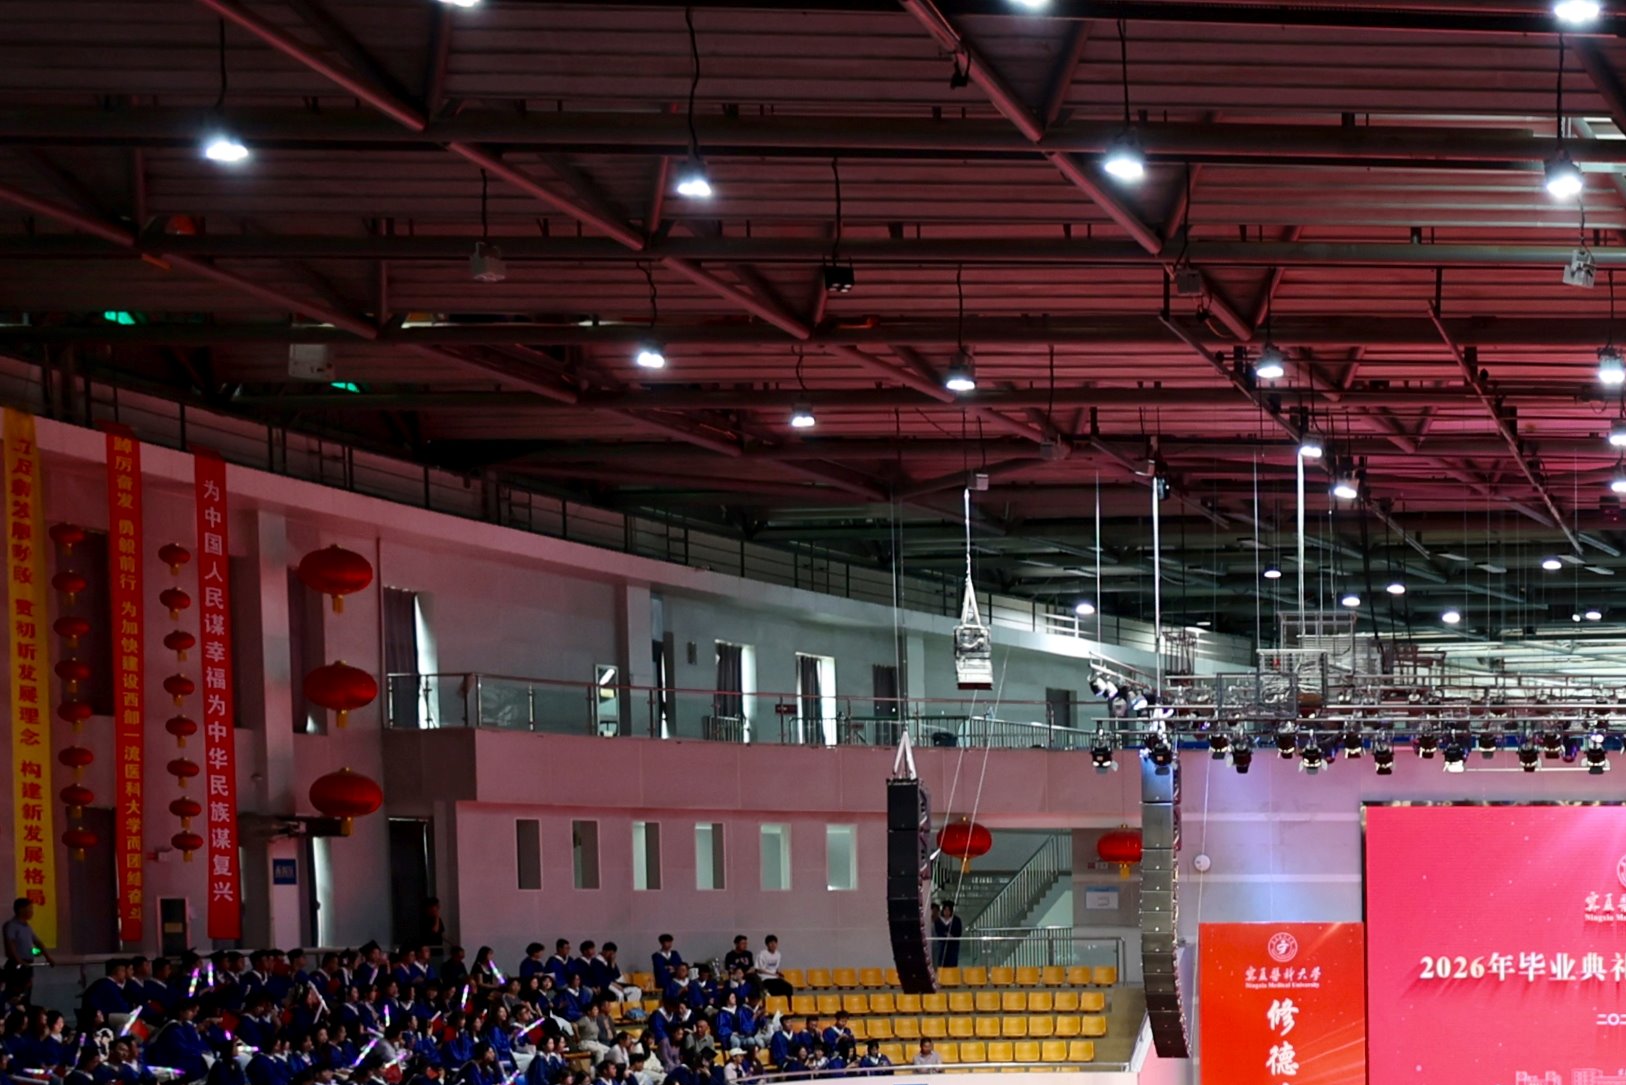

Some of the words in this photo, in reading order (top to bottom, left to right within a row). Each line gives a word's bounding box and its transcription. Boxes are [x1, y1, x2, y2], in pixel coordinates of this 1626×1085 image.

[202, 479, 234, 903] 为中国人民谋幸福为中华民族谋复兴
[1585, 913, 1614, 923] Ningxia
